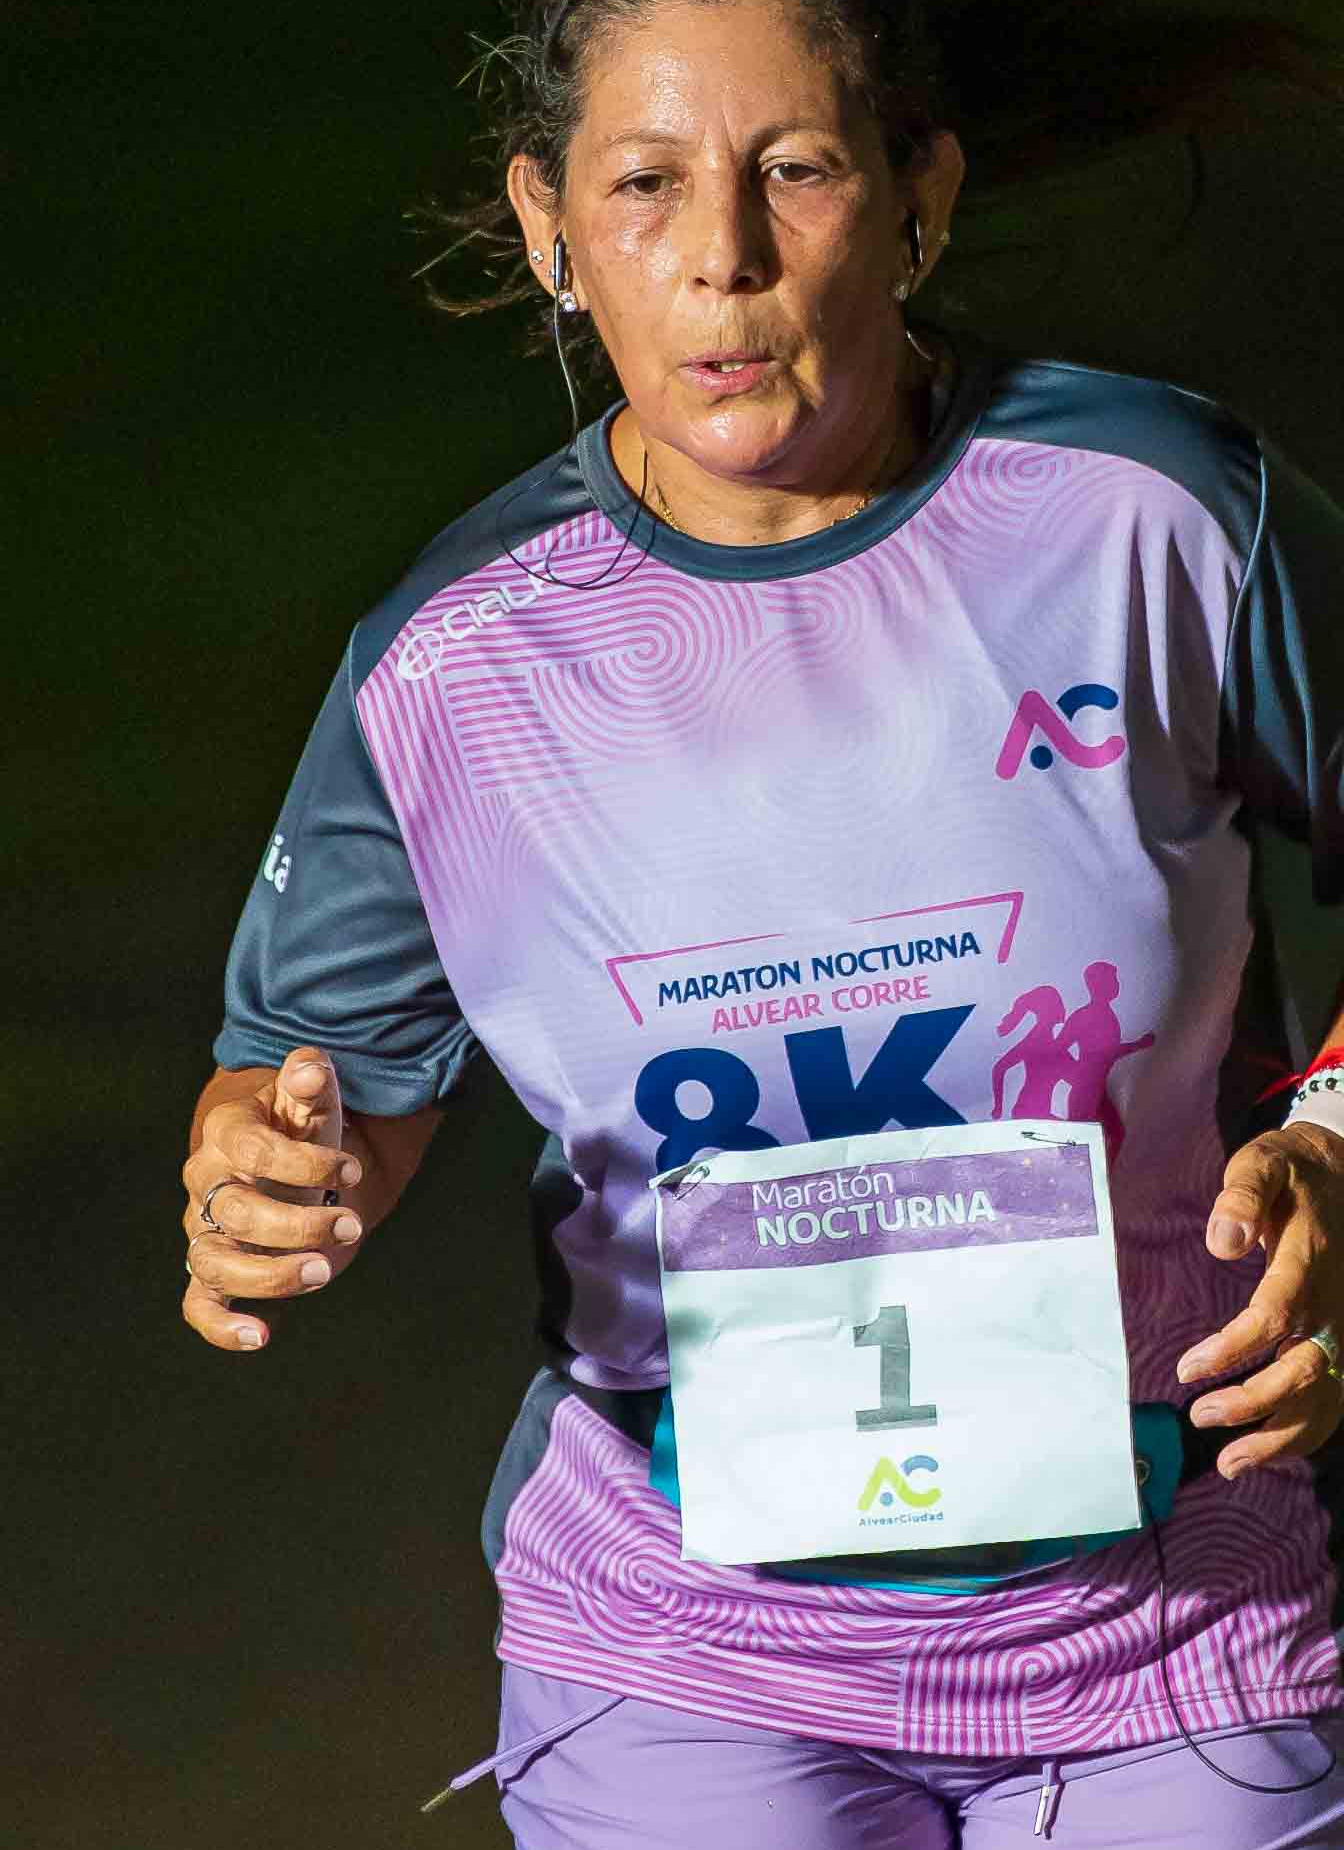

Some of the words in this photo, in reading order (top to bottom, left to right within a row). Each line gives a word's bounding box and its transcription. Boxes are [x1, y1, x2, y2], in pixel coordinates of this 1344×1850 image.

[657, 960, 801, 1007] MARATON
[812, 931, 982, 982] NOCTURNA
[711, 992, 825, 1035] ALVEAR
[831, 974, 932, 1013] CORRE
[634, 1003, 977, 1176] 8K
[752, 1166, 895, 1211] Maratón
[756, 1190, 998, 1247] NOCTURNA
[853, 1304, 937, 1432] 1
